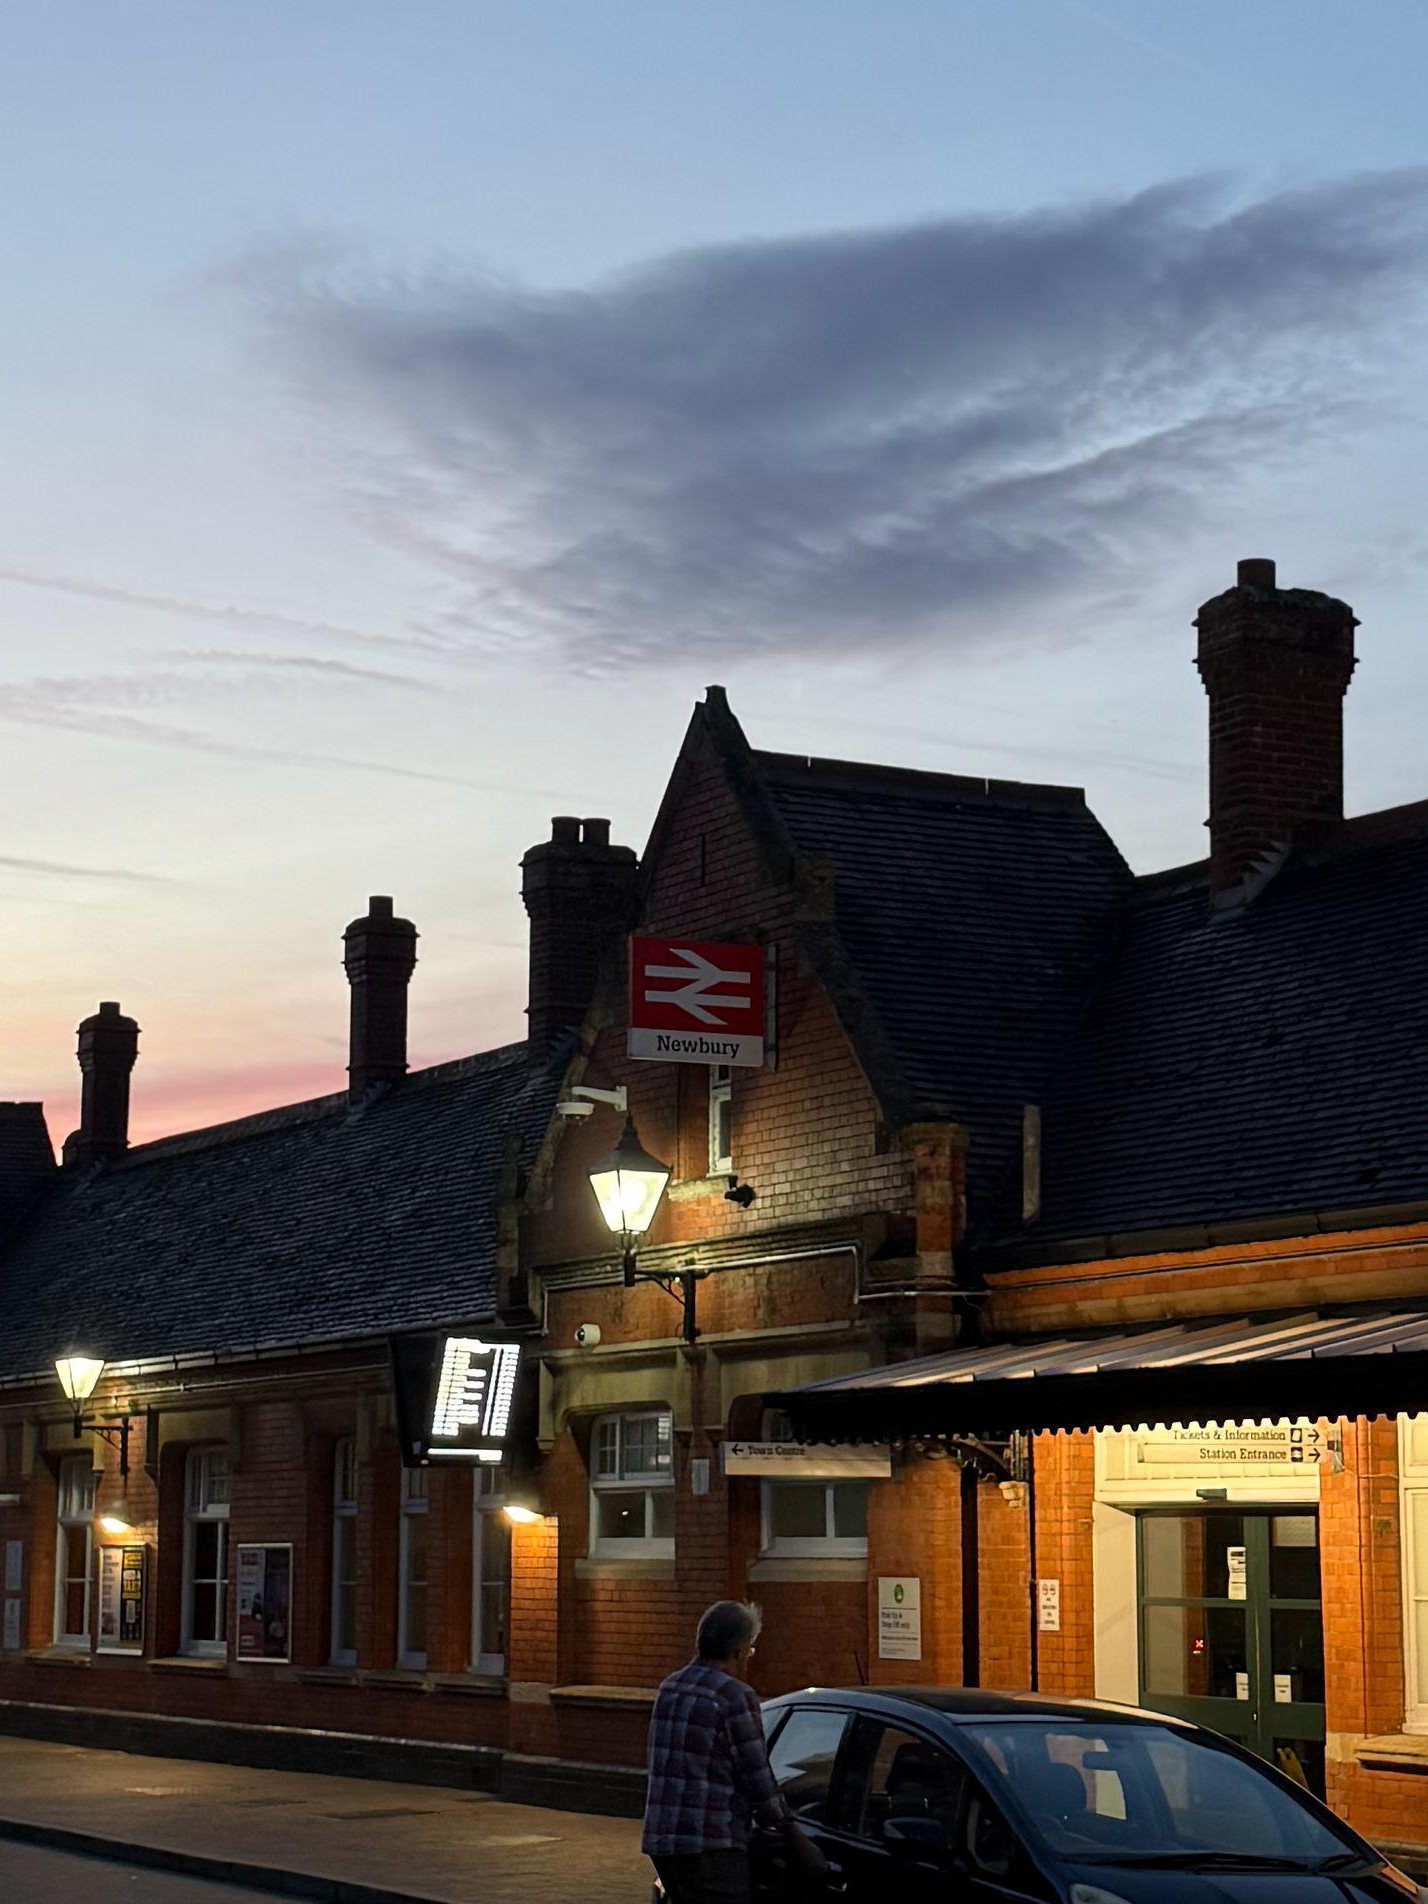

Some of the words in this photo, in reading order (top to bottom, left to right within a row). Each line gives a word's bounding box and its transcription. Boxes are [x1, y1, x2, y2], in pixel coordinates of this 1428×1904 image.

[656, 1034, 740, 1059] Newbury
[1225, 1429, 1286, 1441] Information
[1199, 1447, 1237, 1459] Station
[1239, 1448, 1287, 1460] Entrance
